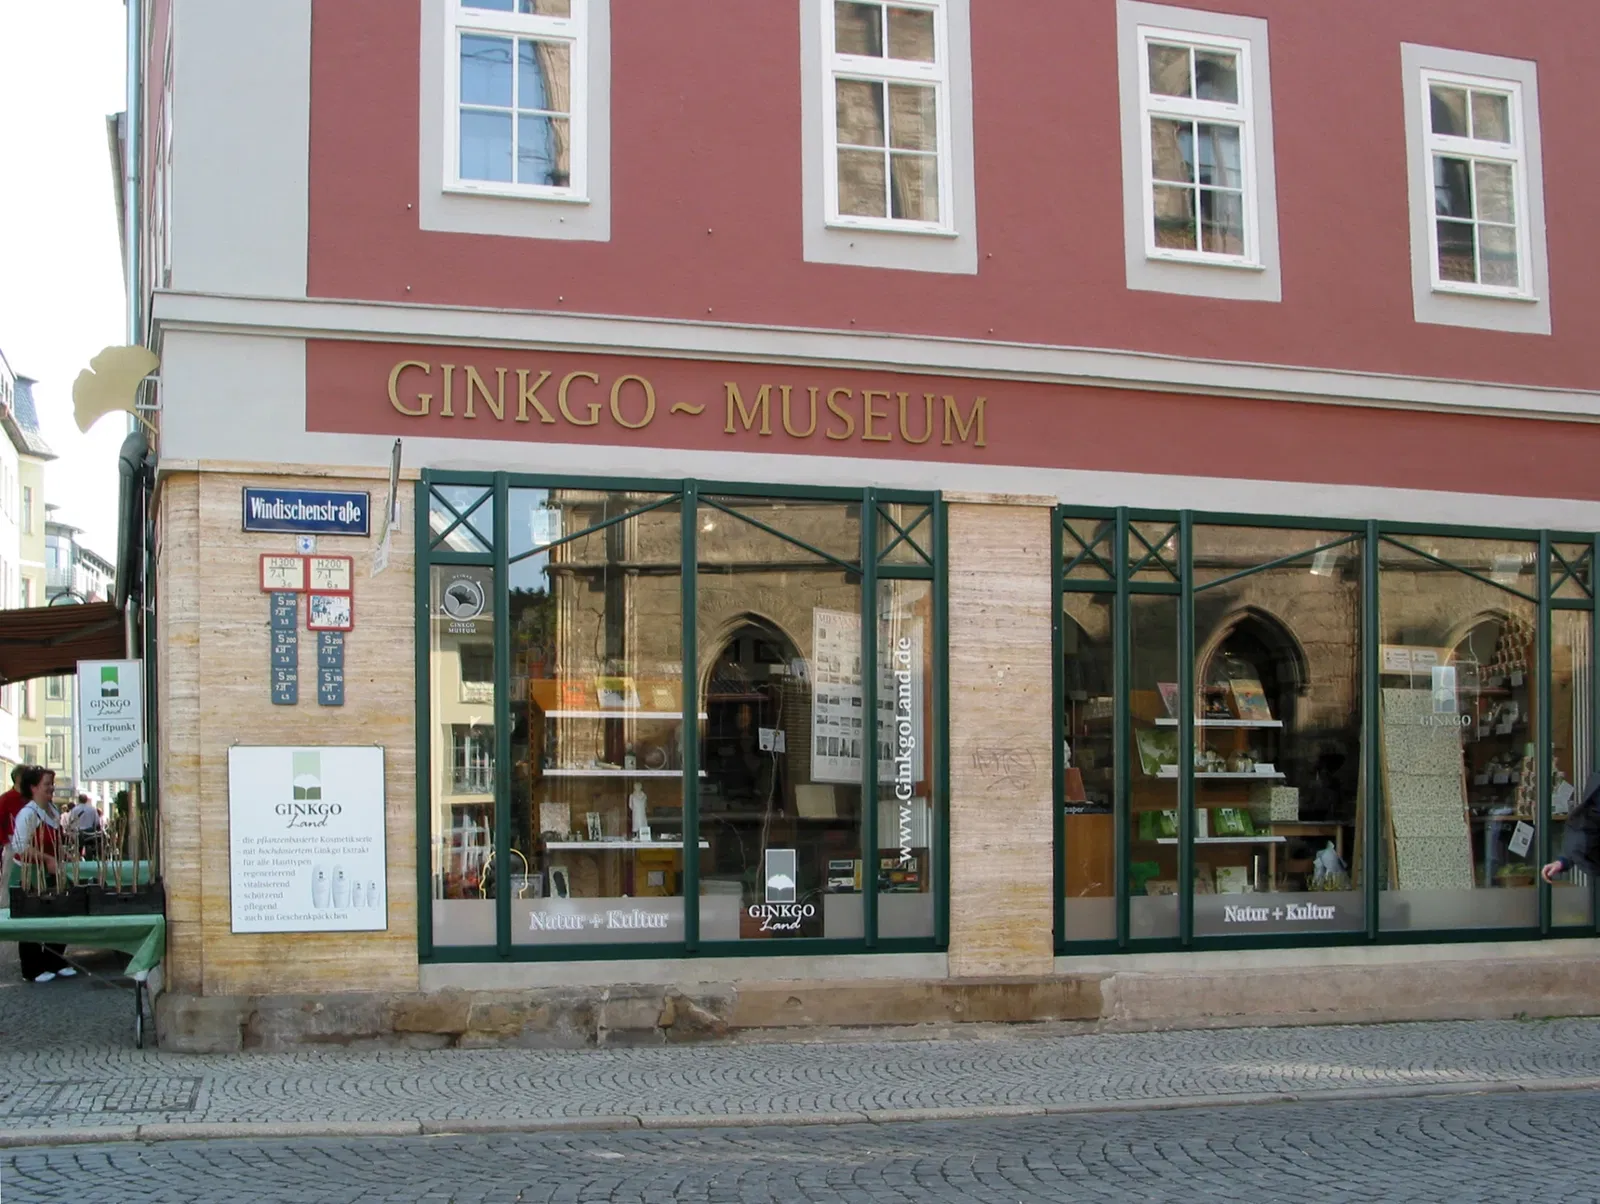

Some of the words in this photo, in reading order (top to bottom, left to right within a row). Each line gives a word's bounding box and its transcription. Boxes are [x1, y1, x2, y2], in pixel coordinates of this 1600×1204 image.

[388, 360, 657, 429] GINKGO
[724, 381, 986, 447] MUSEUM
[251, 497, 361, 524] Windischenstraße
[278, 596, 284, 606] S
[278, 634, 285, 643] S
[325, 635, 331, 644] S
[278, 672, 285, 680] S
[325, 673, 331, 682] S
[90, 700, 131, 708] GINKGO
[87, 723, 136, 733] Treffpunkt
[87, 746, 101, 754] für
[895, 637, 915, 864] www.GinkgoLand.de
[83, 738, 140, 778] Pflanzenjäger
[275, 803, 342, 816] GINKGO
[286, 813, 329, 828] Land
[256, 836, 319, 845] pflanzenbasierte
[314, 847, 341, 855] Ginkgo
[272, 858, 312, 867] Hauttypen
[243, 869, 296, 878] regenerierend
[748, 904, 815, 918] GINKGO
[1224, 905, 1269, 922] Natur
[1272, 907, 1283, 920] +
[1286, 902, 1336, 920] Kultur
[276, 913, 348, 921] Geschenkpäckchen
[529, 911, 586, 930] Natur
[589, 914, 603, 928] +
[606, 908, 669, 928] Kultur
[759, 914, 801, 931] Land
